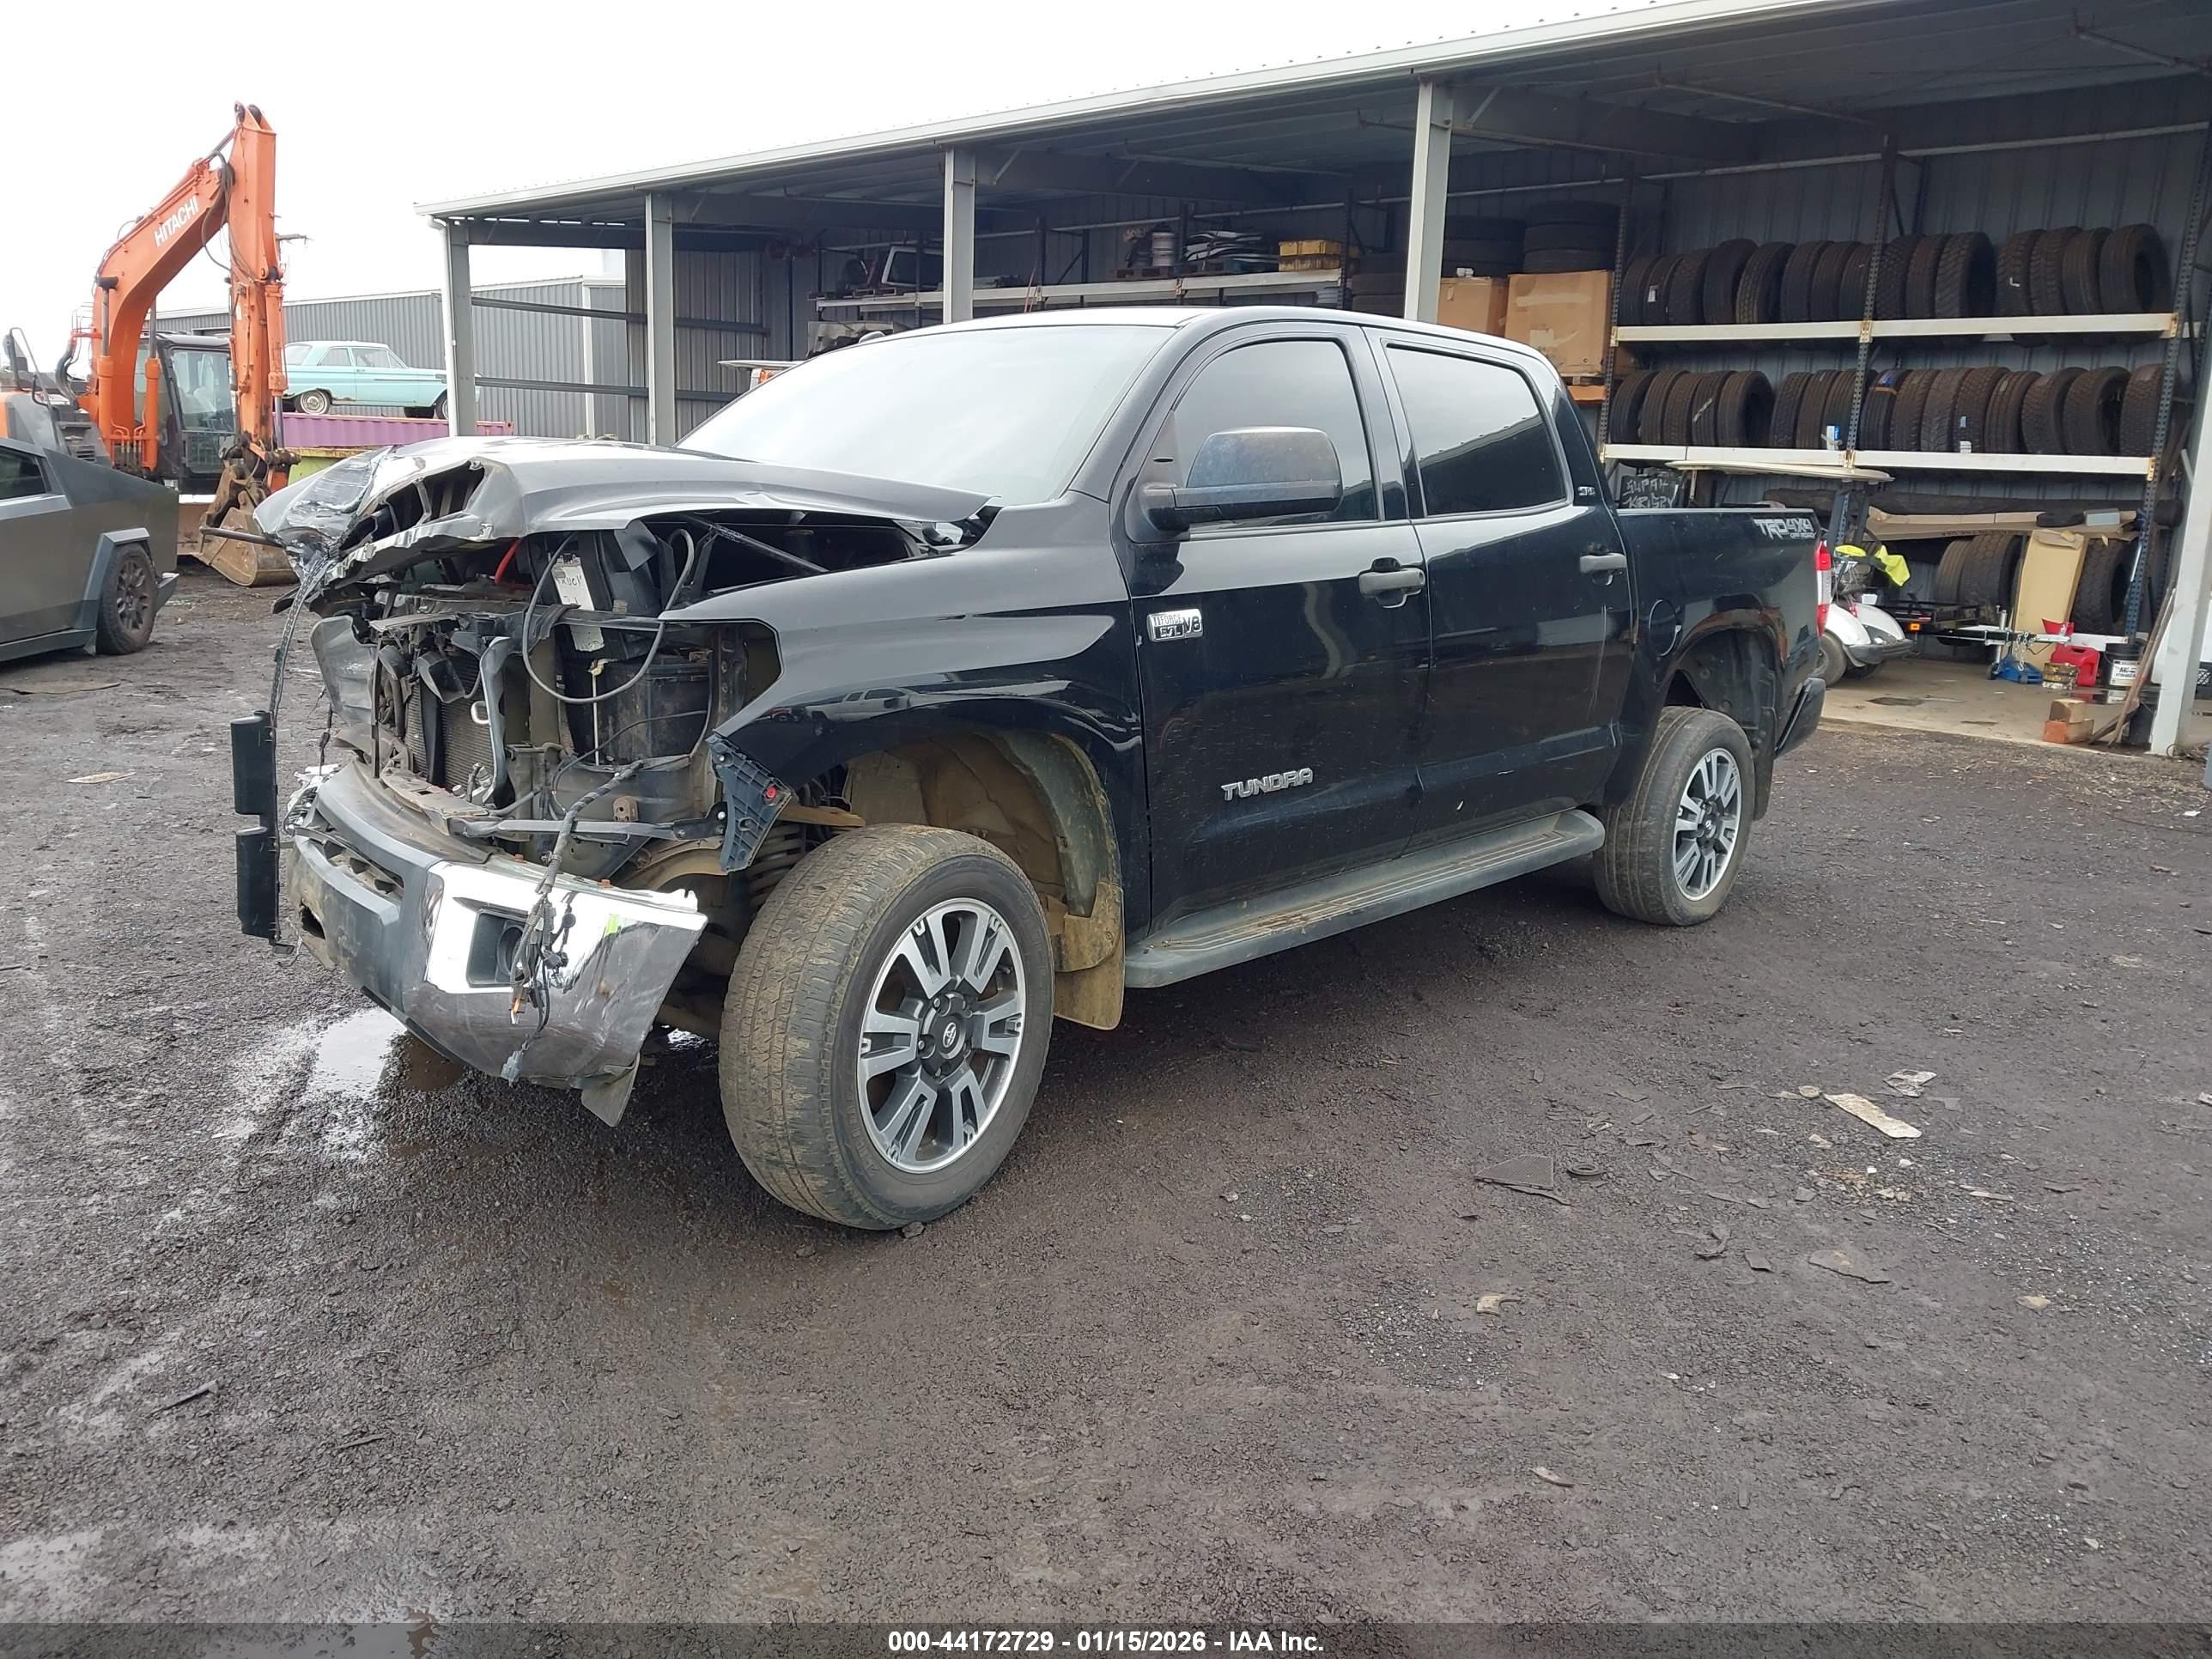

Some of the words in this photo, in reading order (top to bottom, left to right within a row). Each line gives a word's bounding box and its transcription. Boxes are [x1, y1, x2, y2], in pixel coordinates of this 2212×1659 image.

[154, 195, 198, 247] HITACHI
[1753, 519, 1789, 540] TRD
[1183, 616, 1201, 634] V8
[1221, 768, 1313, 800] TUNDRA
